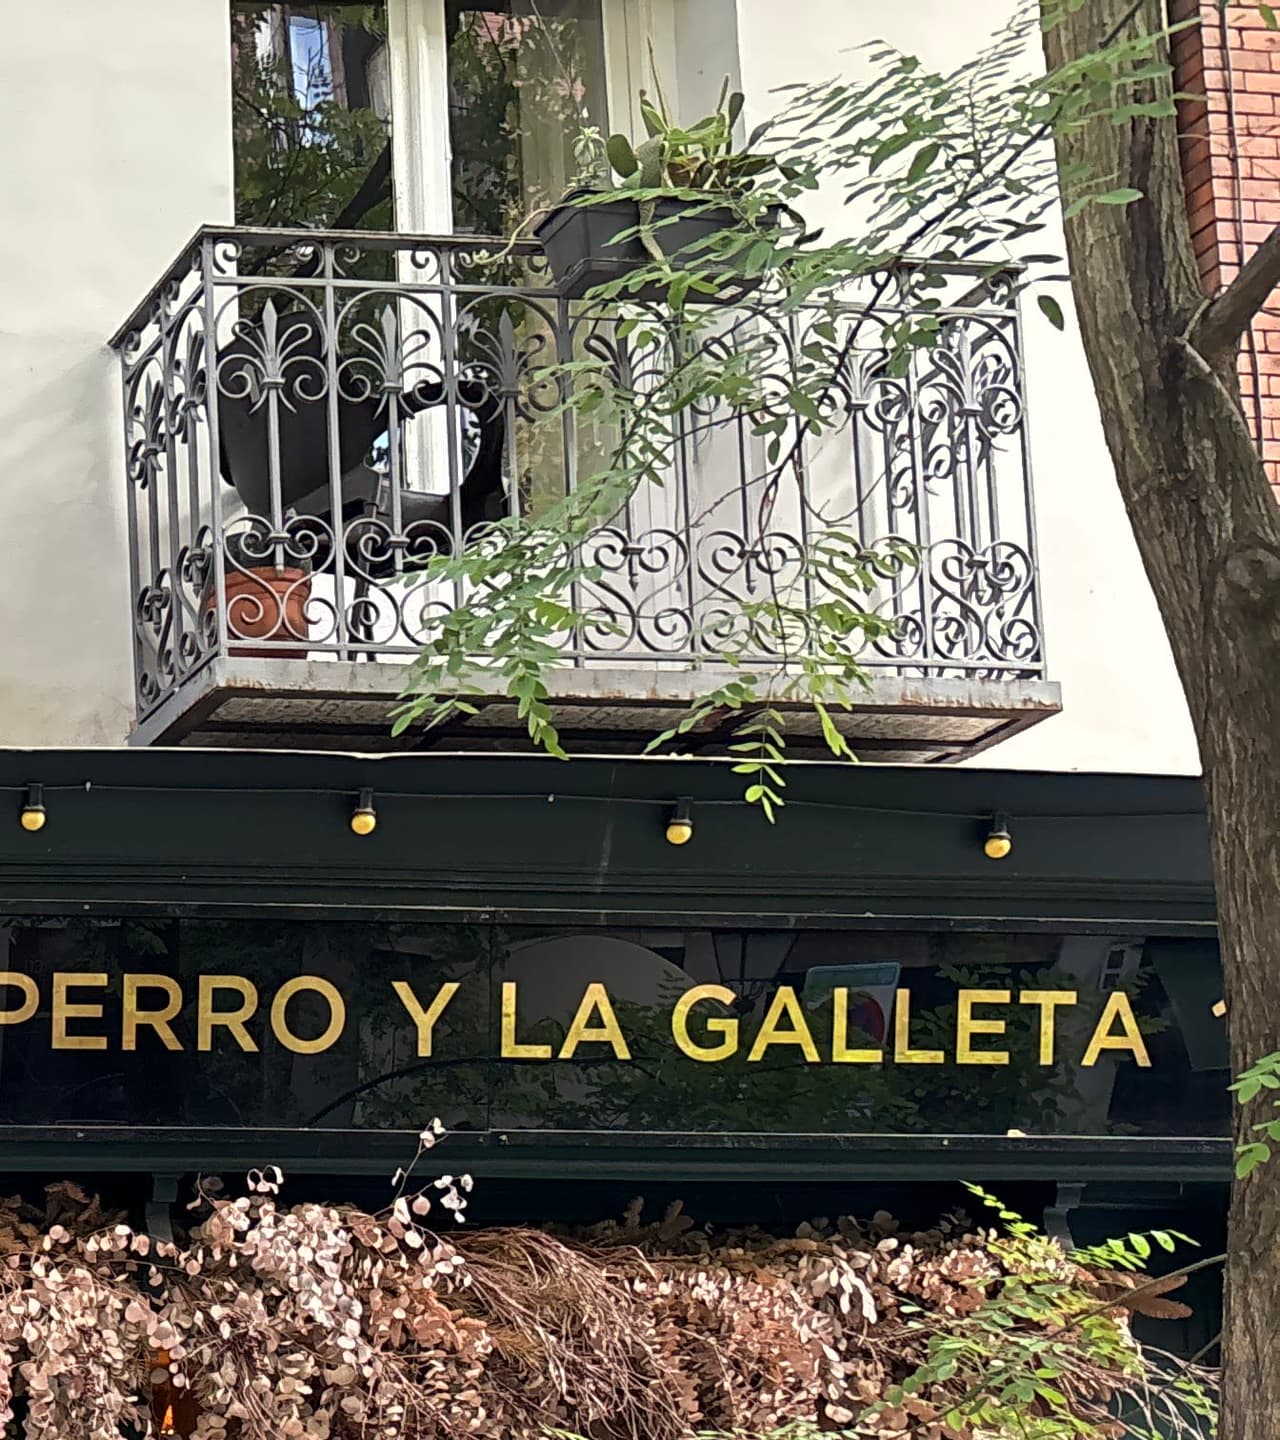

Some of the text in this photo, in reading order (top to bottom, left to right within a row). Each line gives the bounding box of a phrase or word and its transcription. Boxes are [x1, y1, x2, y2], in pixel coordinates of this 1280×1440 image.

[392, 982, 460, 1056] Y
[501, 982, 631, 1059] LA
[672, 984, 1151, 1066] GALLETA
